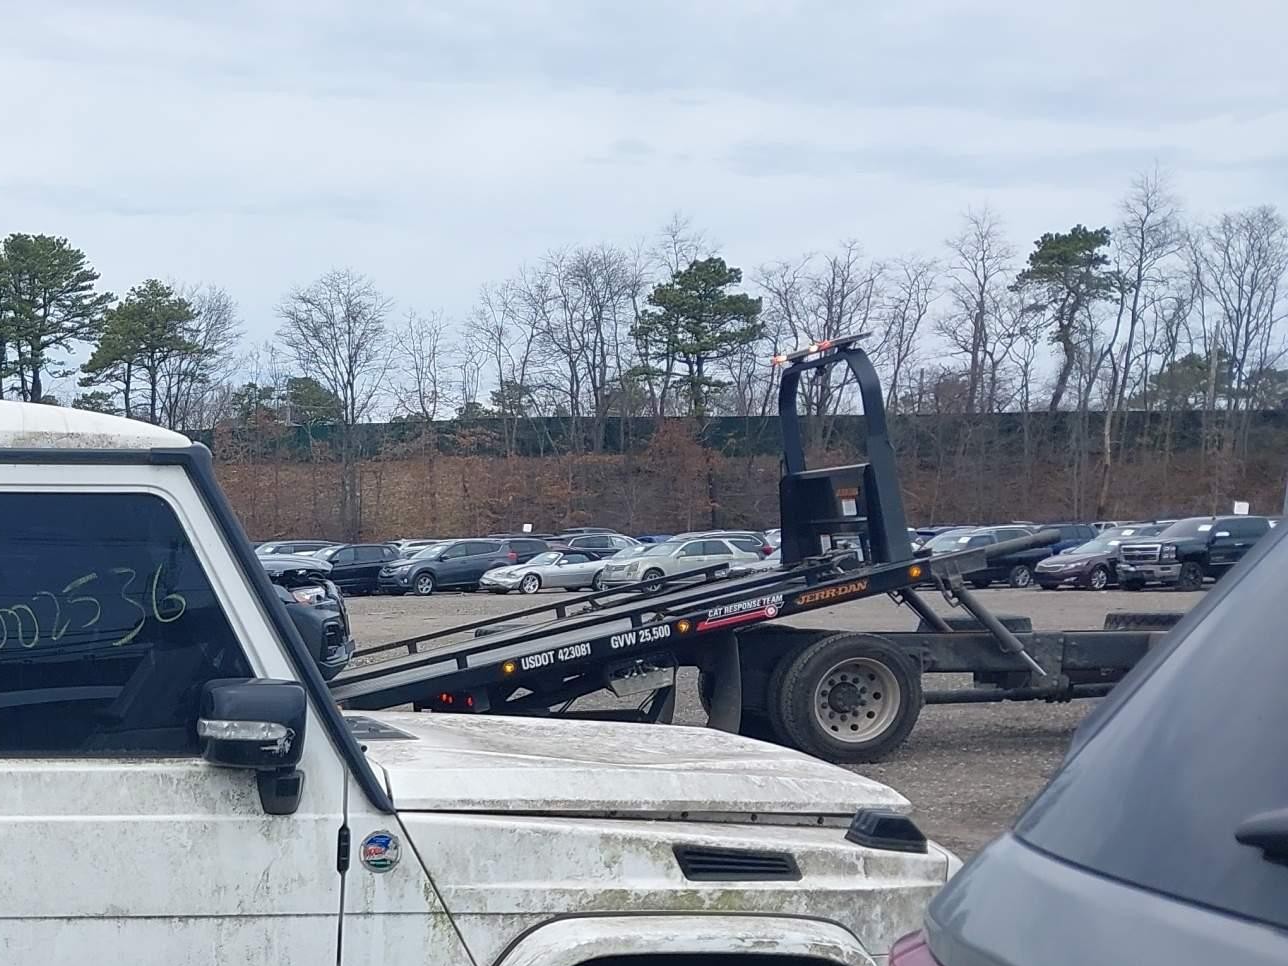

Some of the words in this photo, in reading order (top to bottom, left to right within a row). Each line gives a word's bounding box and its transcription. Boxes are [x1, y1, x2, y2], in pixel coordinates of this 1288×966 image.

[708, 608, 723, 618] CAT
[724, 599, 761, 614] RESPONSE
[762, 594, 783, 606] TEAM
[521, 650, 556, 670] USDOT
[557, 642, 592, 661] 423081
[610, 630, 637, 649] GVW
[639, 624, 671, 643] 25,500
